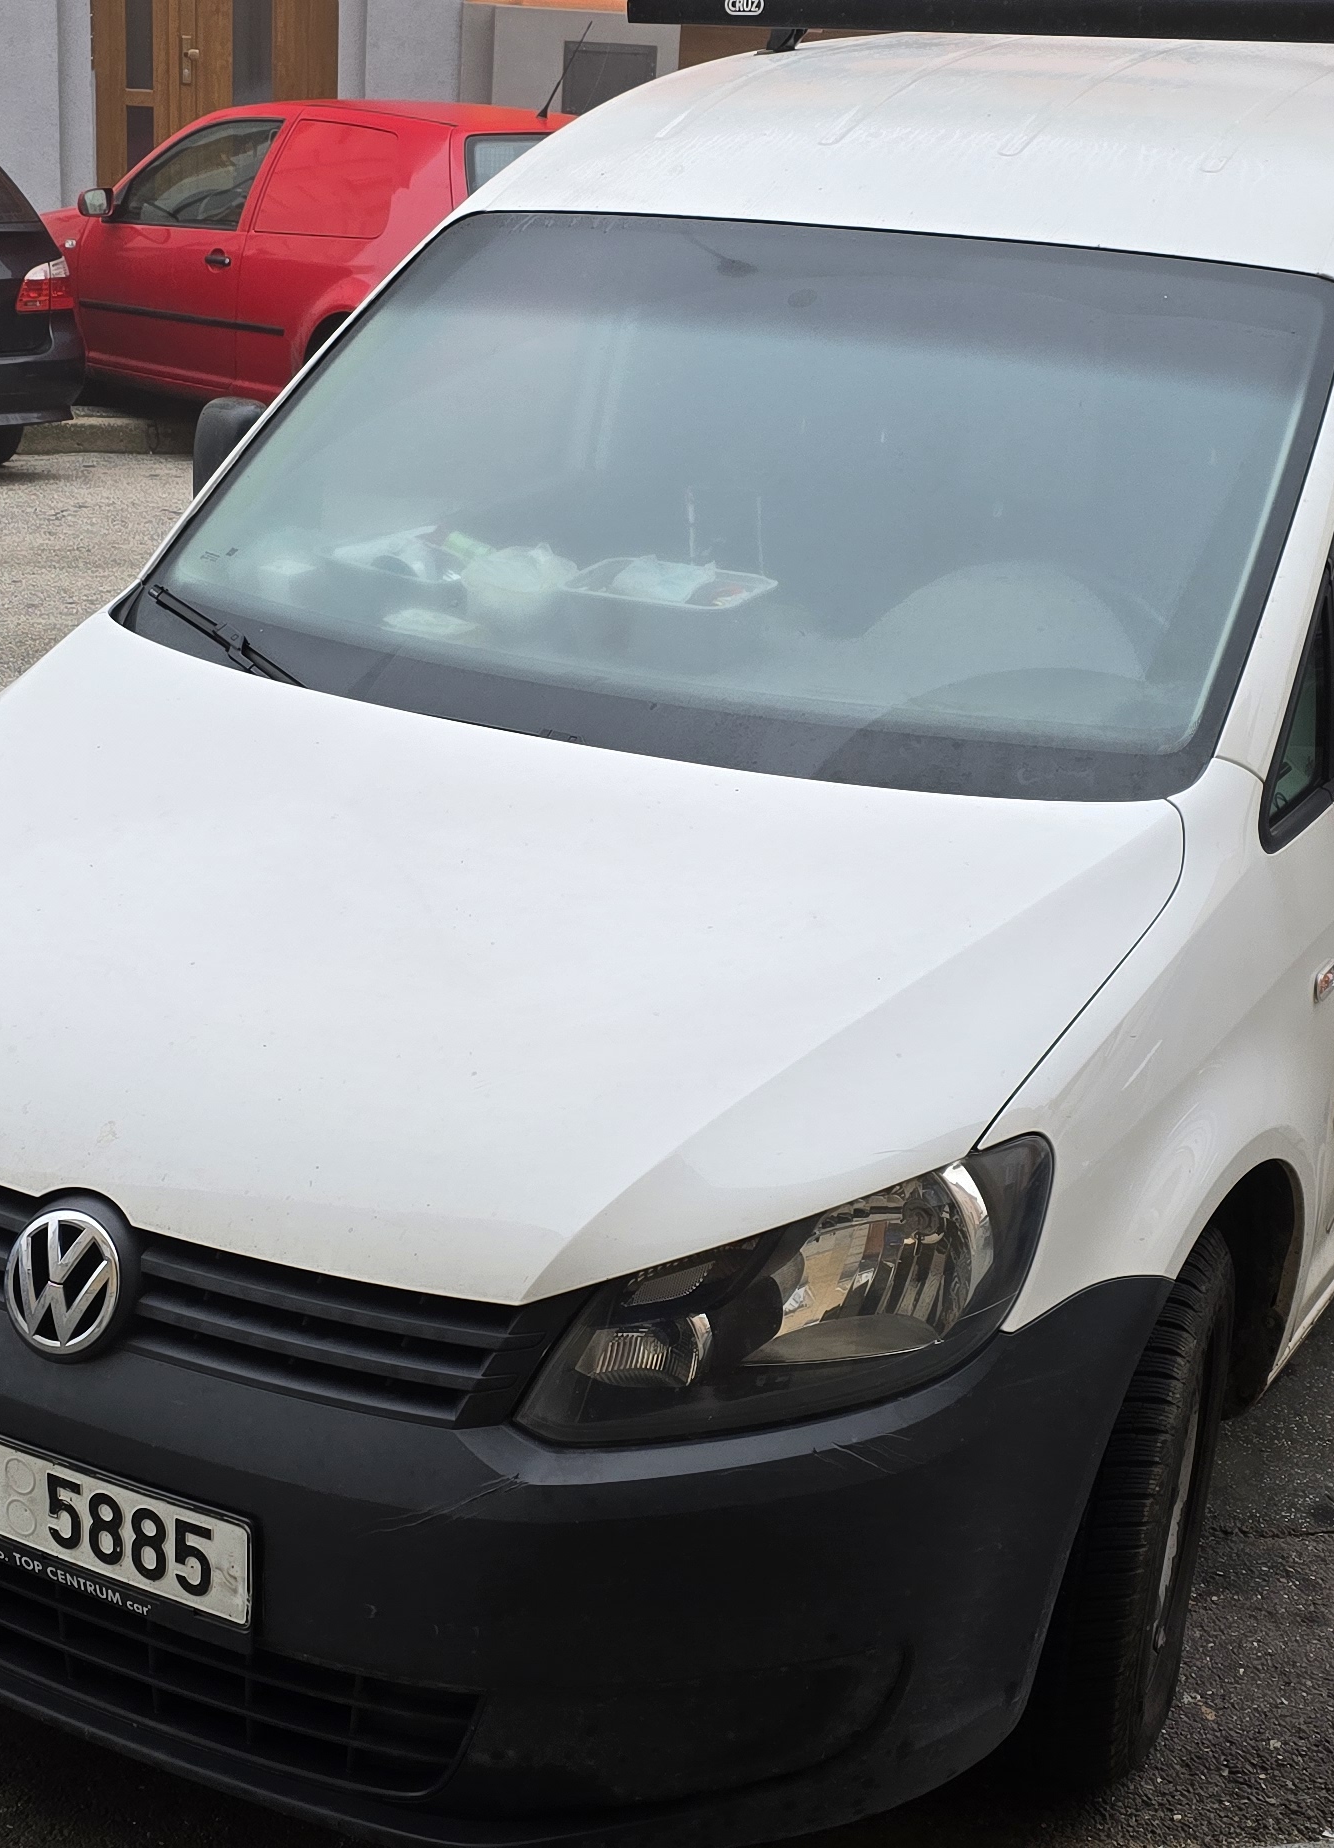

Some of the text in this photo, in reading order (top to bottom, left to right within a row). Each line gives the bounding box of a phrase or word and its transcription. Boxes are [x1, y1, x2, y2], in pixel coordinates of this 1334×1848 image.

[728, 0, 759, 11] CRUZ
[47, 1470, 213, 1597] 5885
[13, 1552, 43, 1574] TOP
[47, 1566, 123, 1606] CENTRUM
